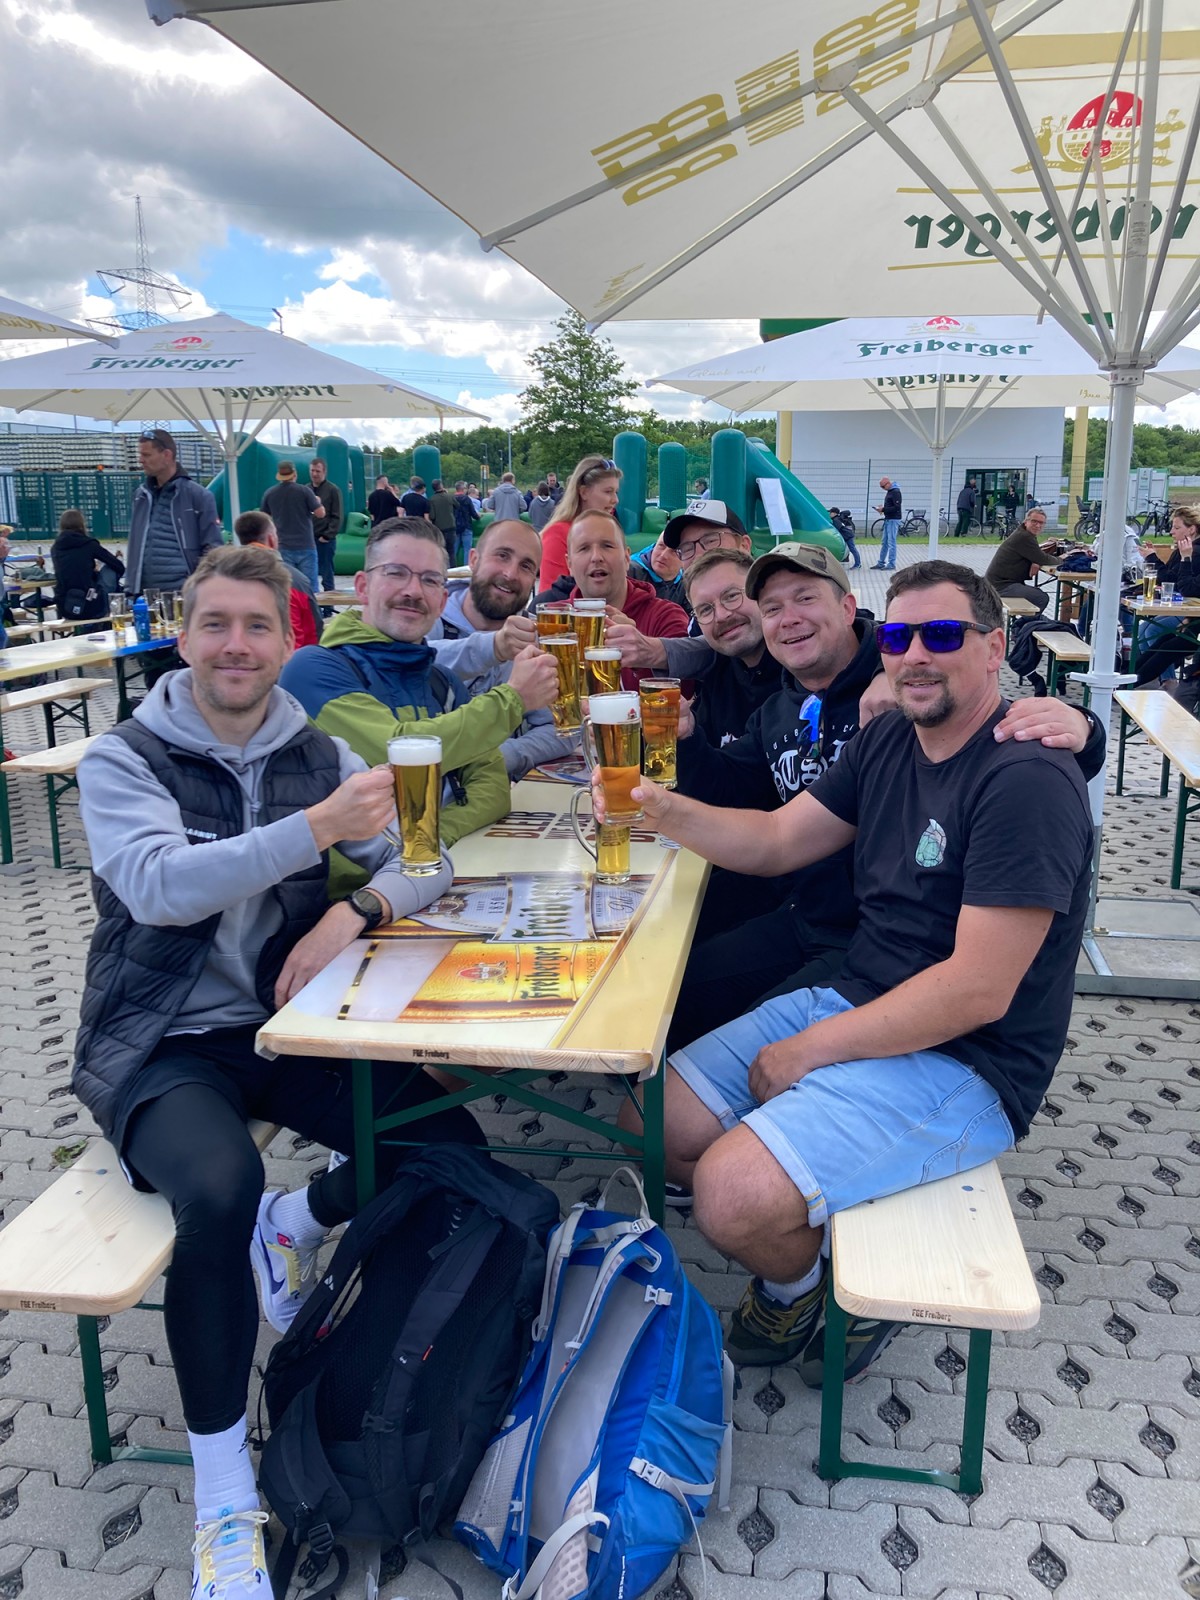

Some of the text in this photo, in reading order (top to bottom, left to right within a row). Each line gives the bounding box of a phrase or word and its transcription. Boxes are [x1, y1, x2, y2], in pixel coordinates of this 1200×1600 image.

[857, 338, 1035, 358] Freiberger
[84, 356, 244, 371] Freiberger
[484, 811, 556, 838] BLEIB
[520, 946, 568, 999] Freiberger
[924, 1310, 952, 1322] Freiberg
